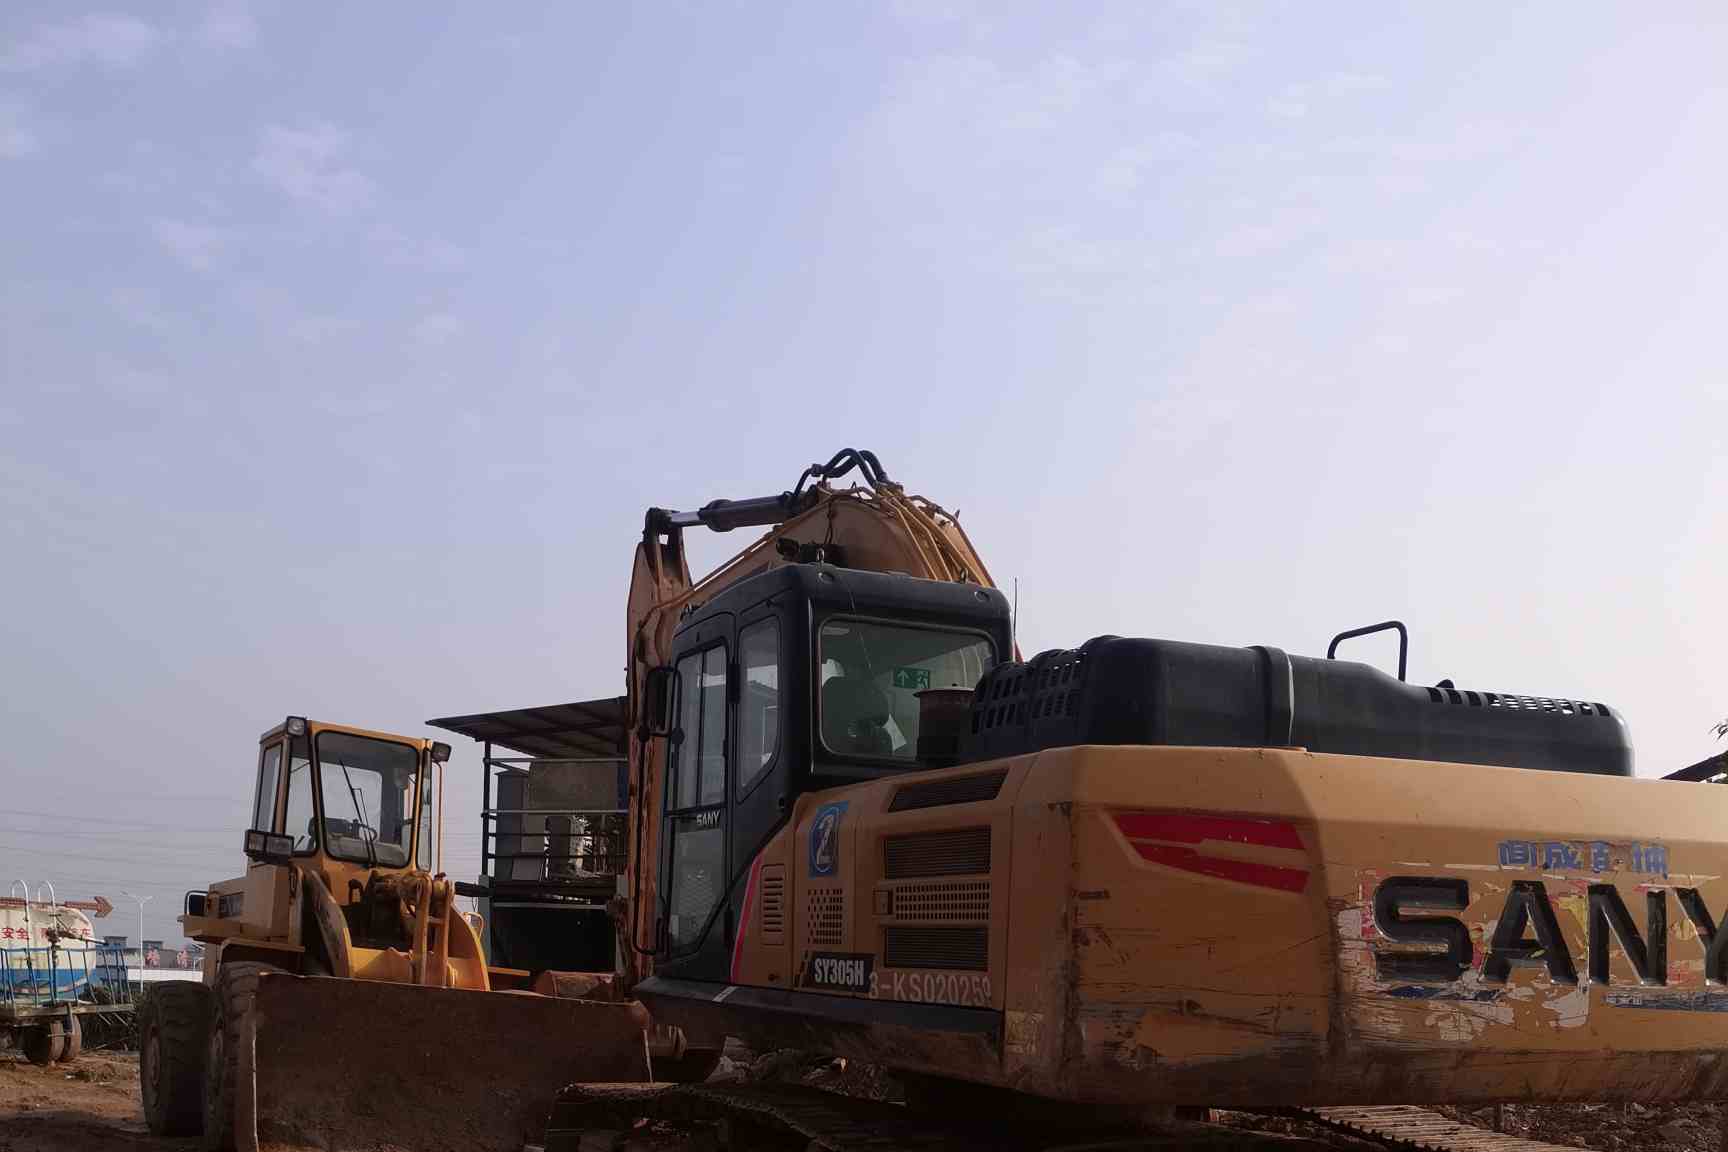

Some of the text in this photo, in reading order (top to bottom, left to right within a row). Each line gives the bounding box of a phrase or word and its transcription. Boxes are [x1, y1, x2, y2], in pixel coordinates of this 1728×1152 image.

[696, 809, 721, 826] SANY
[1372, 875, 1728, 986] SANY
[814, 958, 866, 987] SY305H
